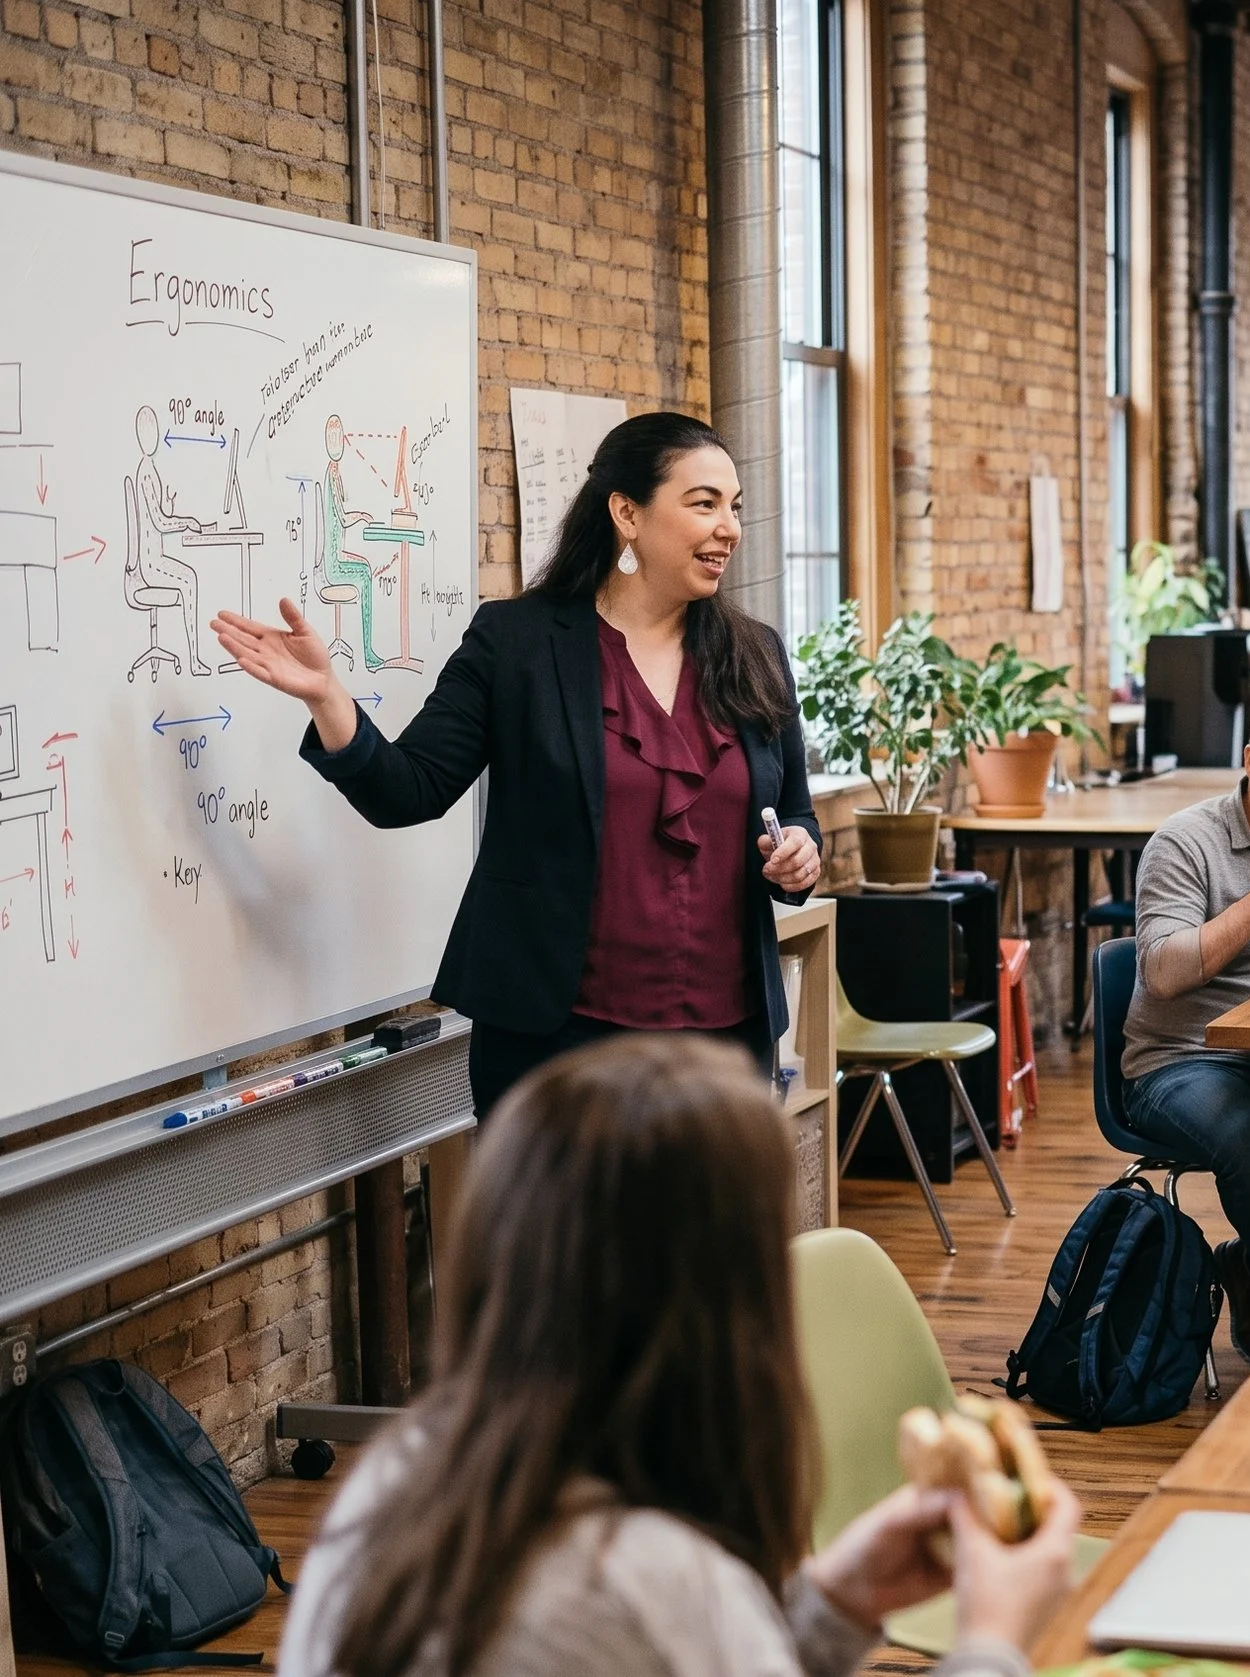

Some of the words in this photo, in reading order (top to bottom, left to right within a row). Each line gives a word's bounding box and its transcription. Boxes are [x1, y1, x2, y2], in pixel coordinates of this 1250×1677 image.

[130, 238, 274, 336] Ergonomics
[169, 397, 192, 425] 90°
[194, 399, 225, 437] angle
[179, 735, 207, 769] 90°
[197, 786, 226, 824] 90°
[228, 788, 270, 839] angle
